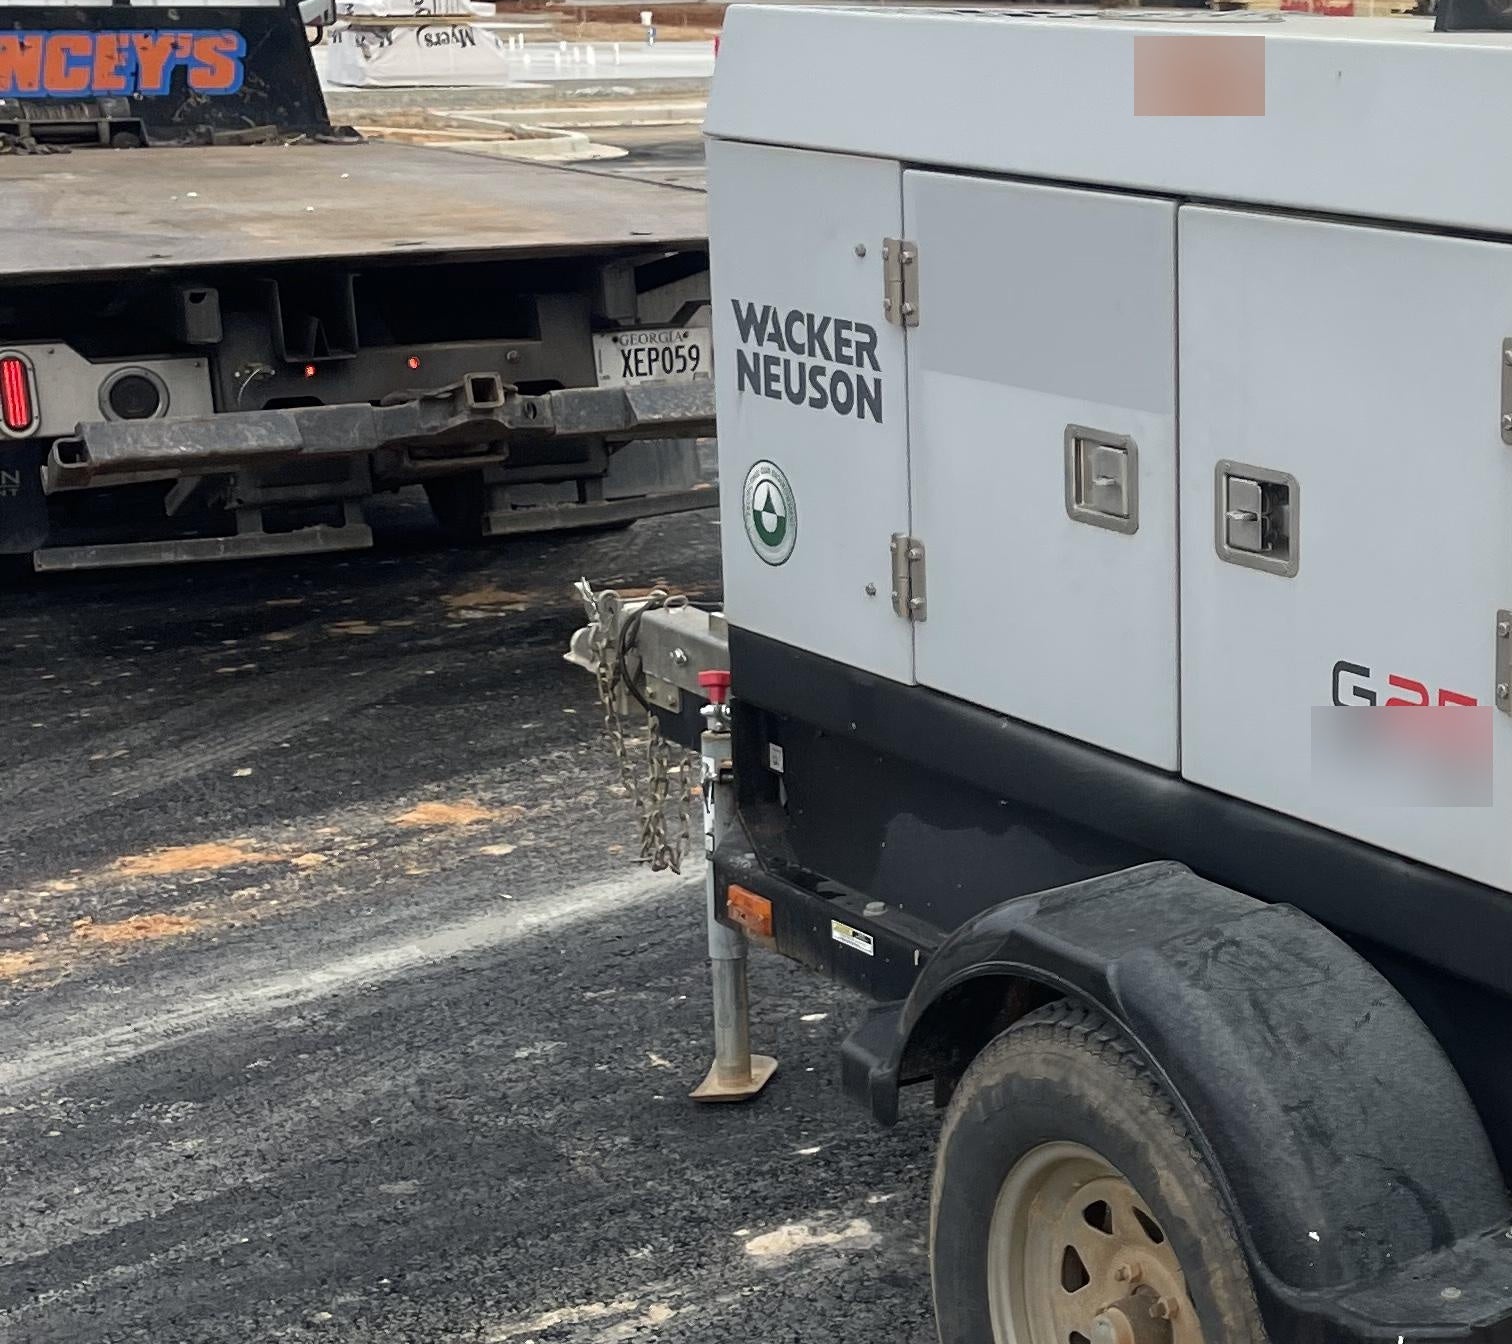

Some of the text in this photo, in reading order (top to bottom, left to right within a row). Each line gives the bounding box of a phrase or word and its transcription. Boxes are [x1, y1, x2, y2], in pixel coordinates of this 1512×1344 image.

[619, 330, 684, 347] GEORGIA
[620, 344, 700, 378] XEP059
[731, 298, 883, 373] WACKER
[736, 348, 884, 425] NEUSON
